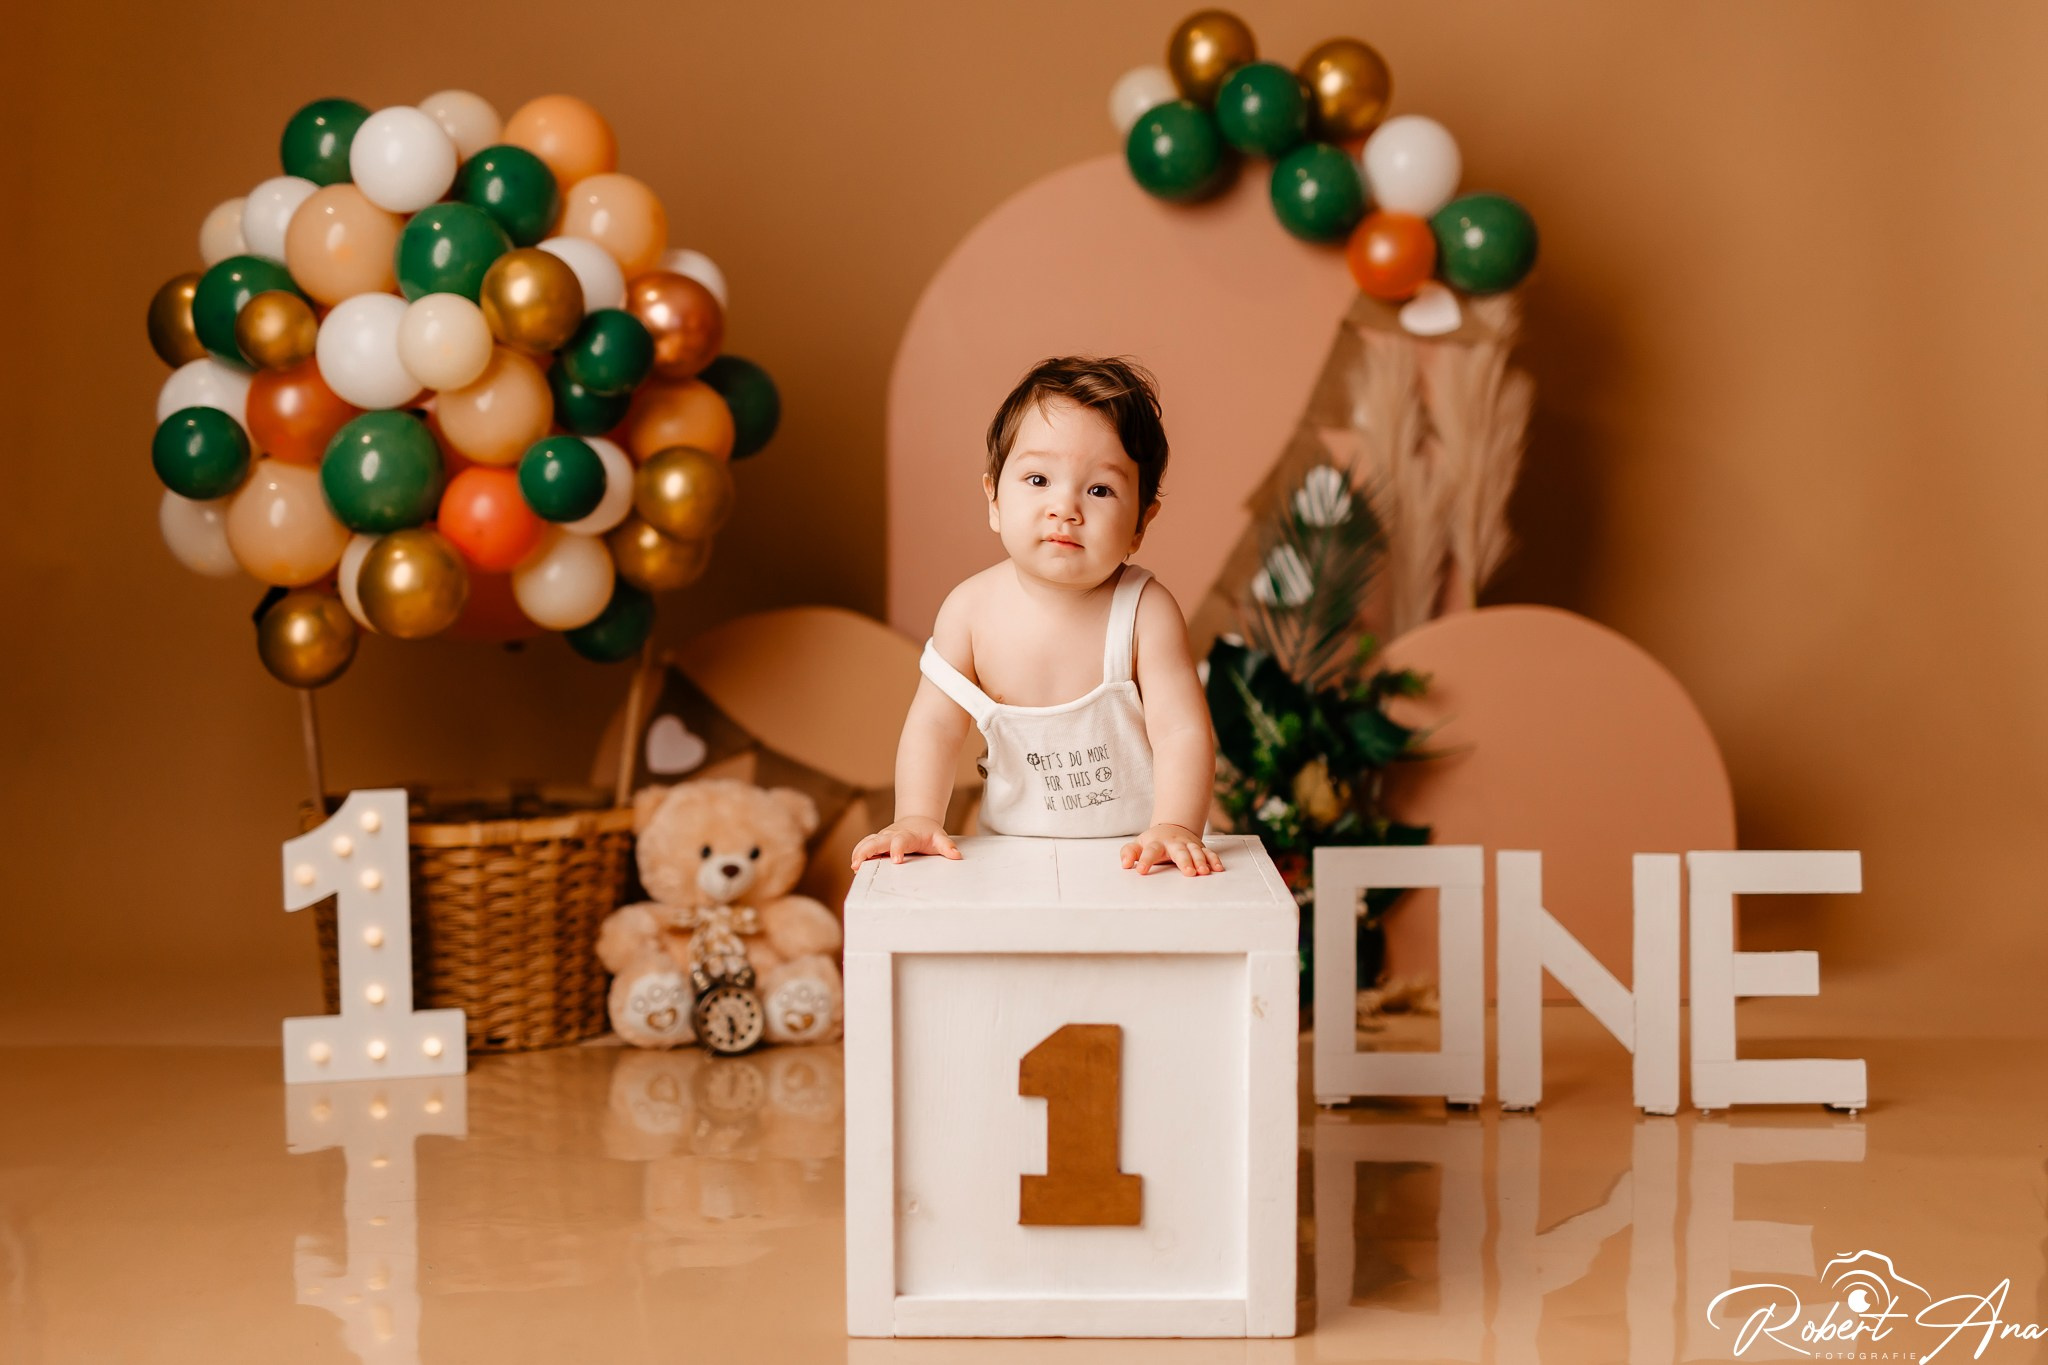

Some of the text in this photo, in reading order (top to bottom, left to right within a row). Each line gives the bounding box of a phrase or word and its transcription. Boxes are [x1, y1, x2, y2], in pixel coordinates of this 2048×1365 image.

[1044, 771, 1091, 792] FOR THIS
[1044, 794, 1083, 811] WE LOVE
[1068, 751, 1083, 768] DO
[1087, 744, 1110, 763] MORE
[283, 788, 467, 1083] 1
[1313, 845, 1867, 1113] ONE
[1019, 1023, 1143, 1226] 1
